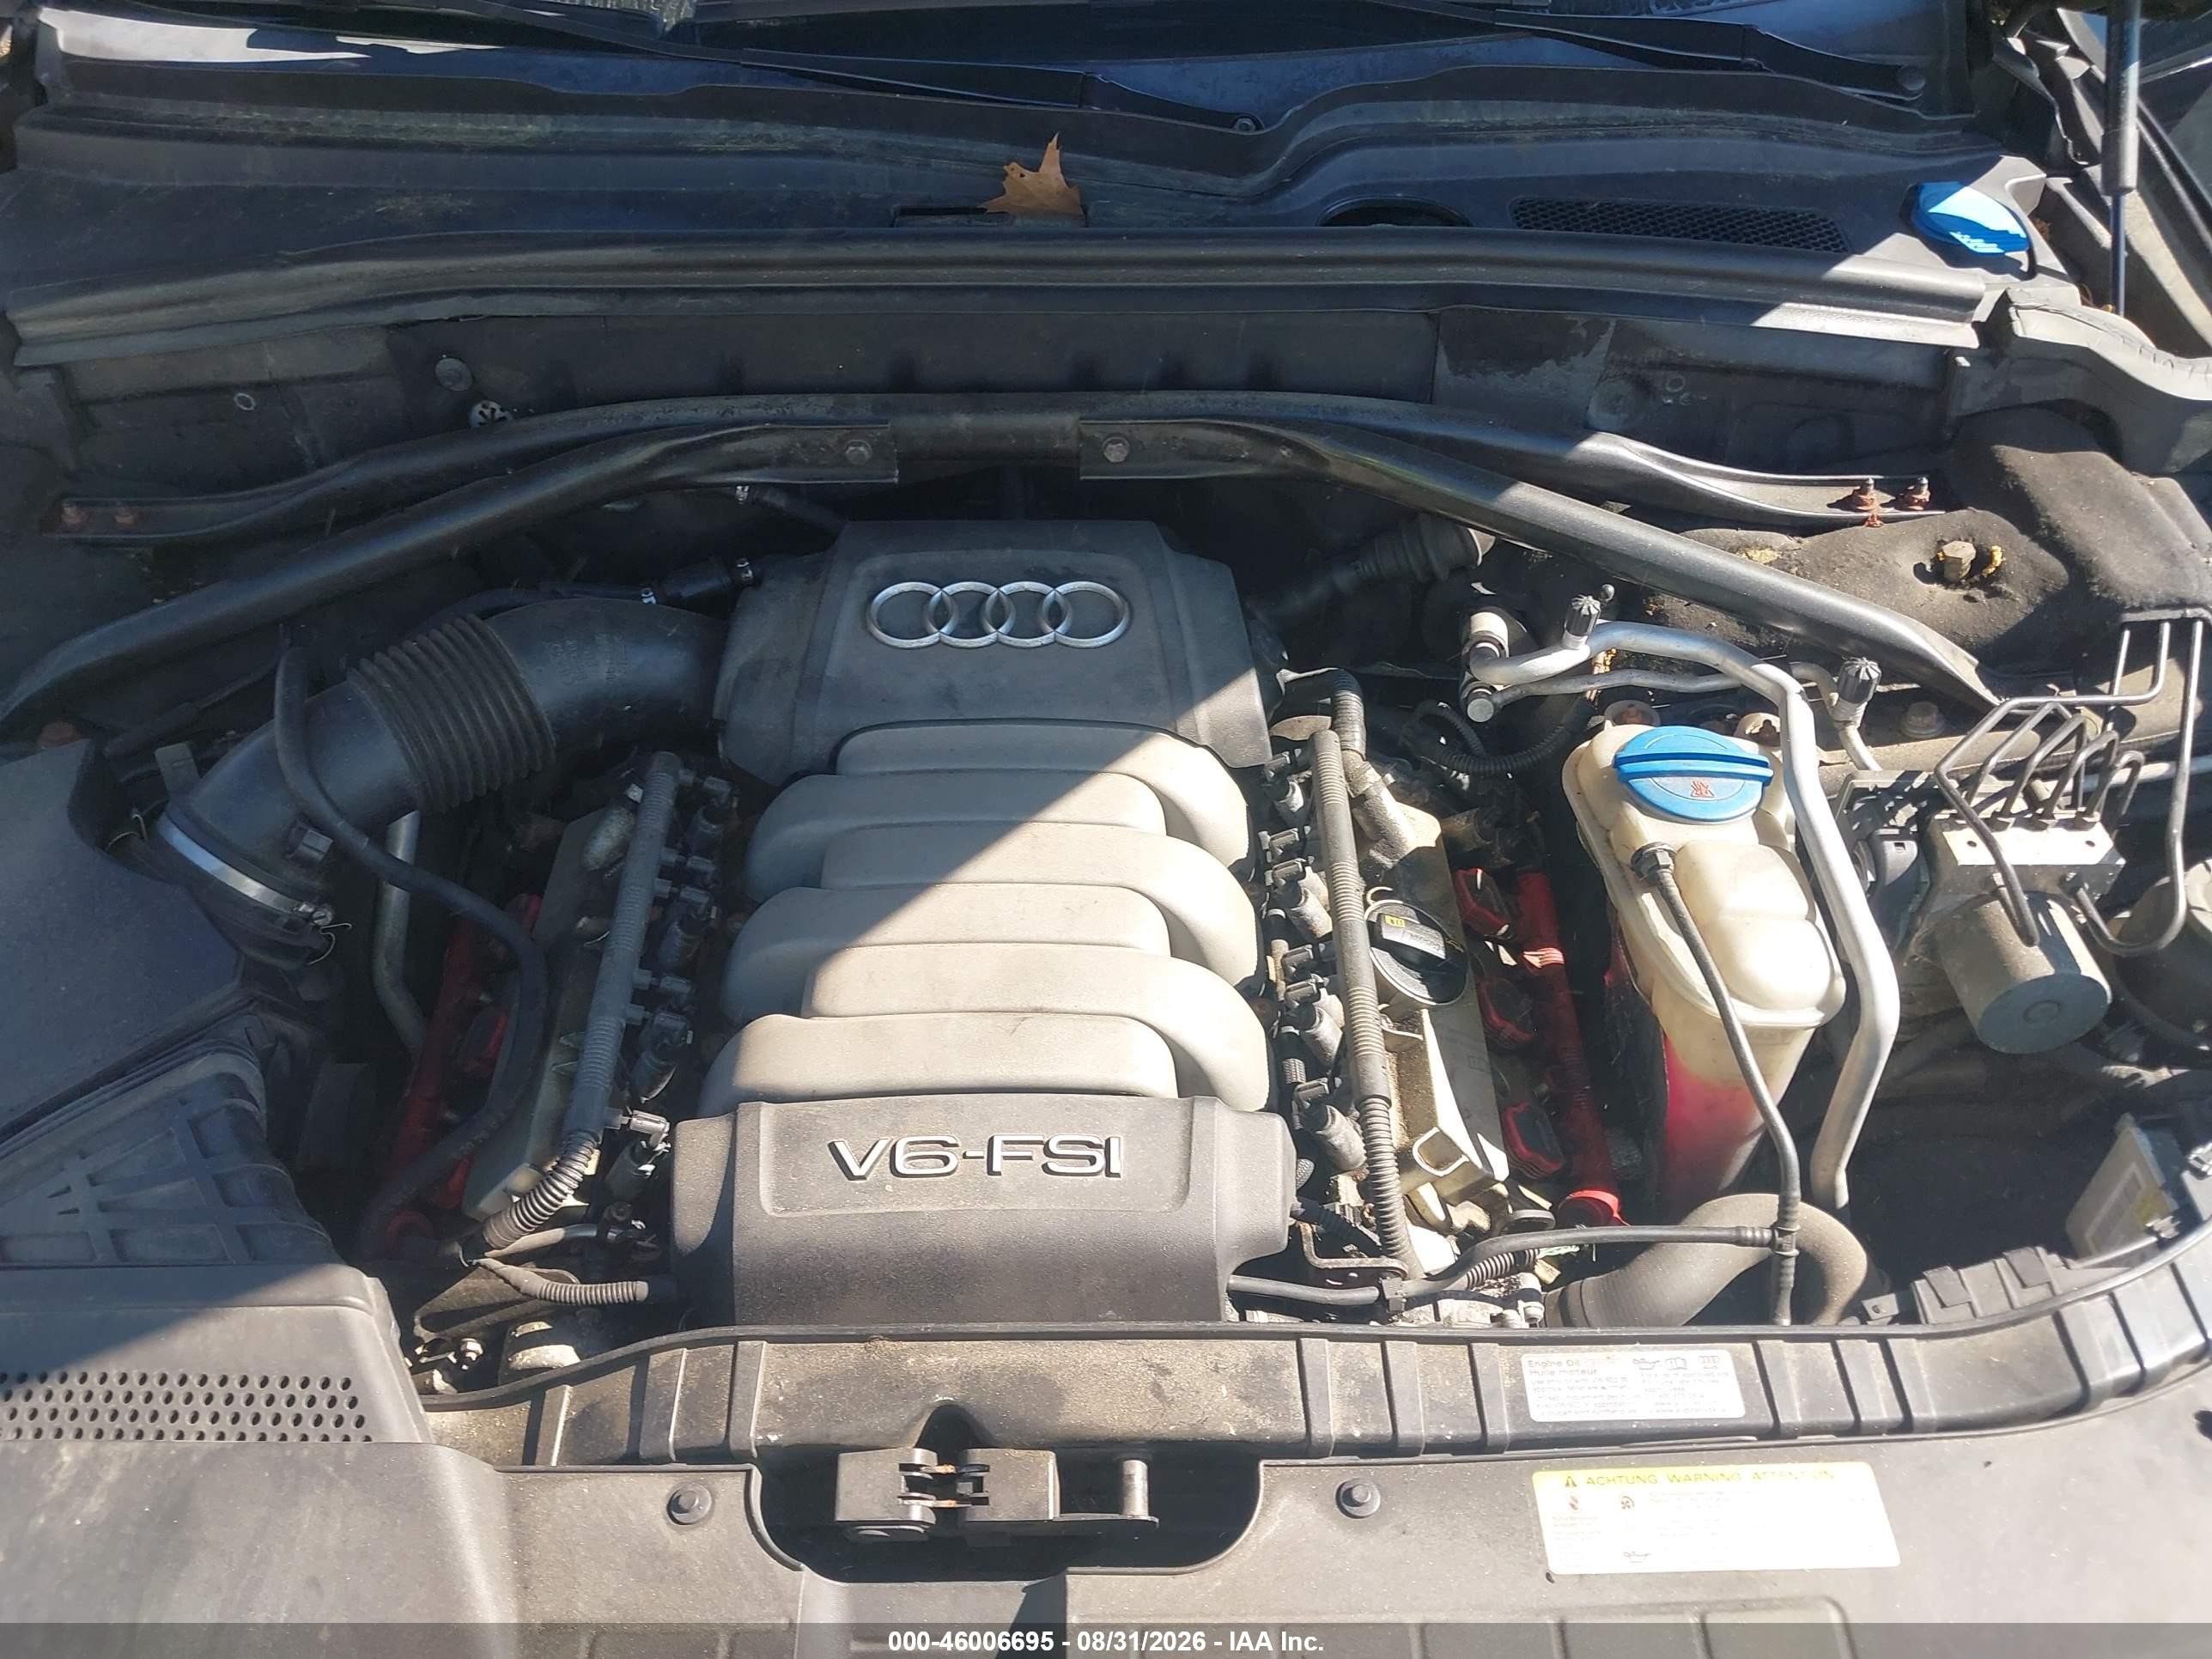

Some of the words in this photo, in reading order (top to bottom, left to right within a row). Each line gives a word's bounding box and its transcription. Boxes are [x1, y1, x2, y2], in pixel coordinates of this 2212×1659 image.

[827, 1134, 1123, 1182] V6-FSI
[1528, 1359, 1564, 1370] Engine
[1586, 1474, 1658, 1486] ACHTUNG
[1667, 1472, 1741, 1484] WARNING
